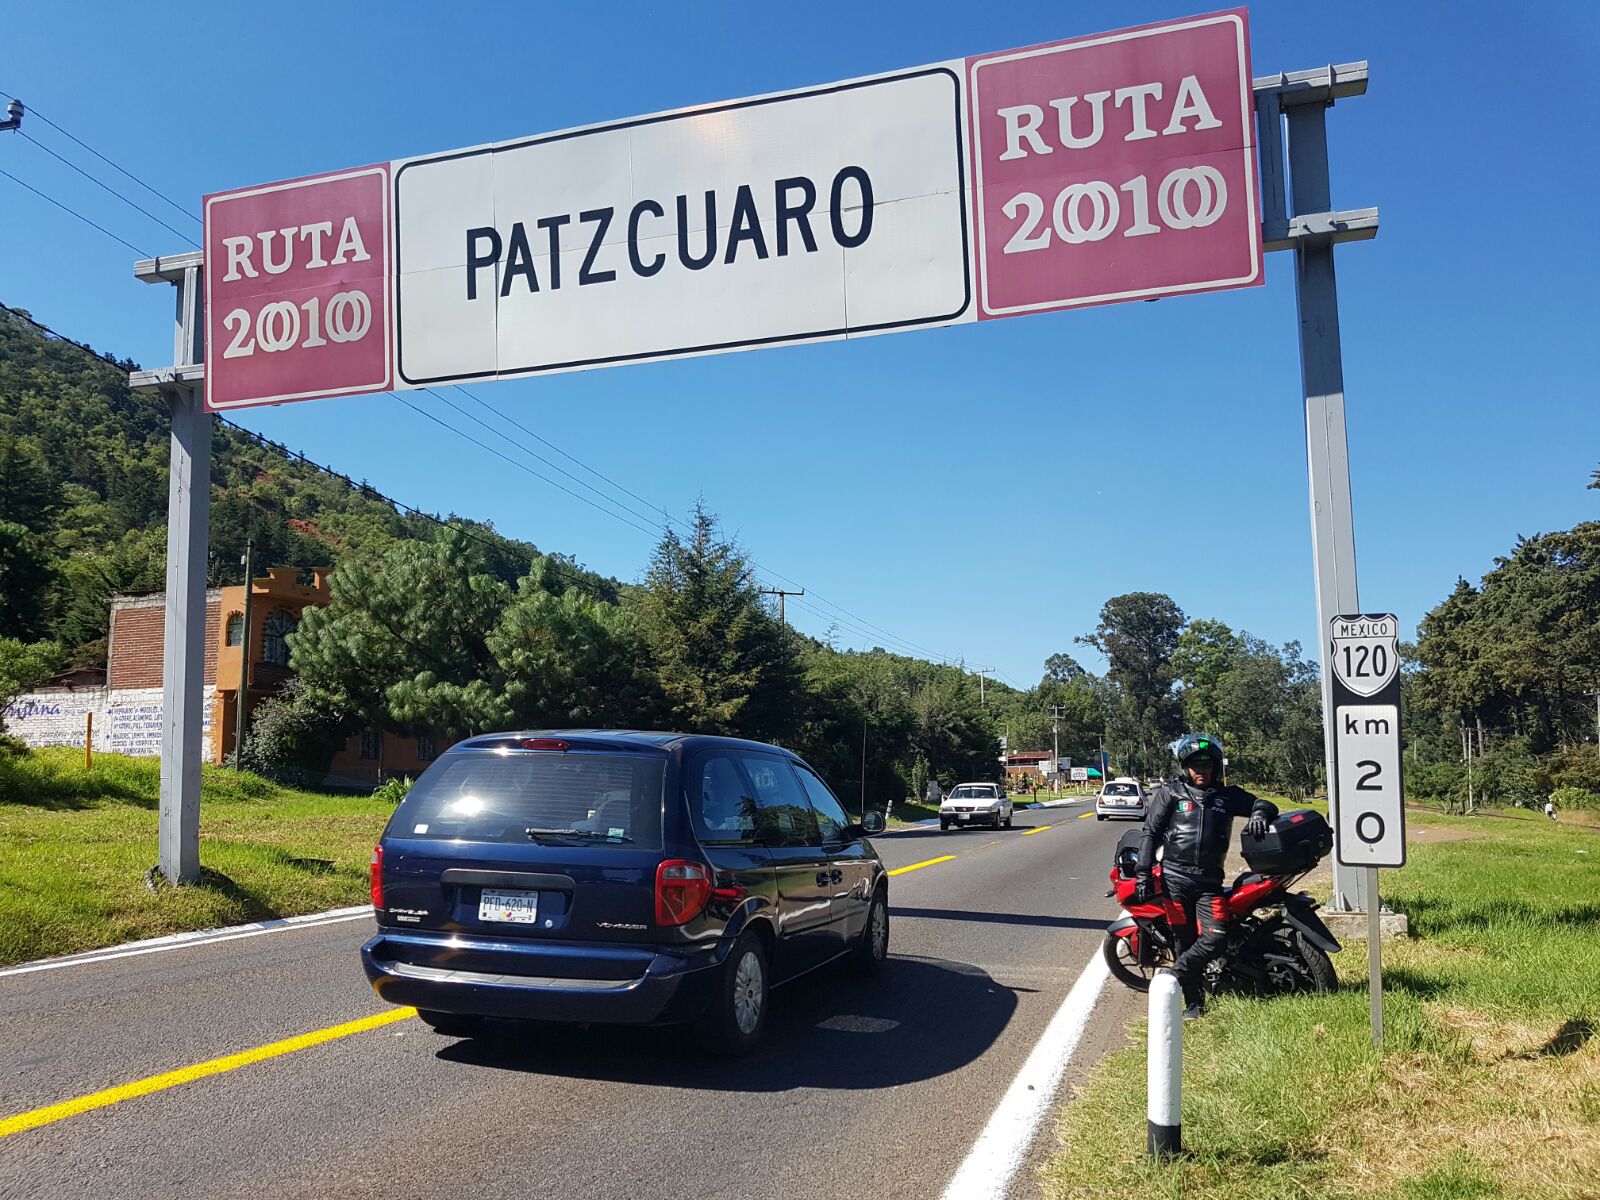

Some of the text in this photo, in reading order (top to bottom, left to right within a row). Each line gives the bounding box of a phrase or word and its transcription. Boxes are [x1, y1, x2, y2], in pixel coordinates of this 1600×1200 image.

[997, 75, 1222, 161] RUTA
[466, 165, 874, 300] PATZCUARO
[222, 216, 371, 282] RUTA
[1340, 623, 1388, 636] MEXICO
[1343, 644, 1387, 678] 120
[5, 699, 61, 718] ristina
[1345, 713, 1389, 735] km
[482, 896, 534, 913] PFD-620-N
